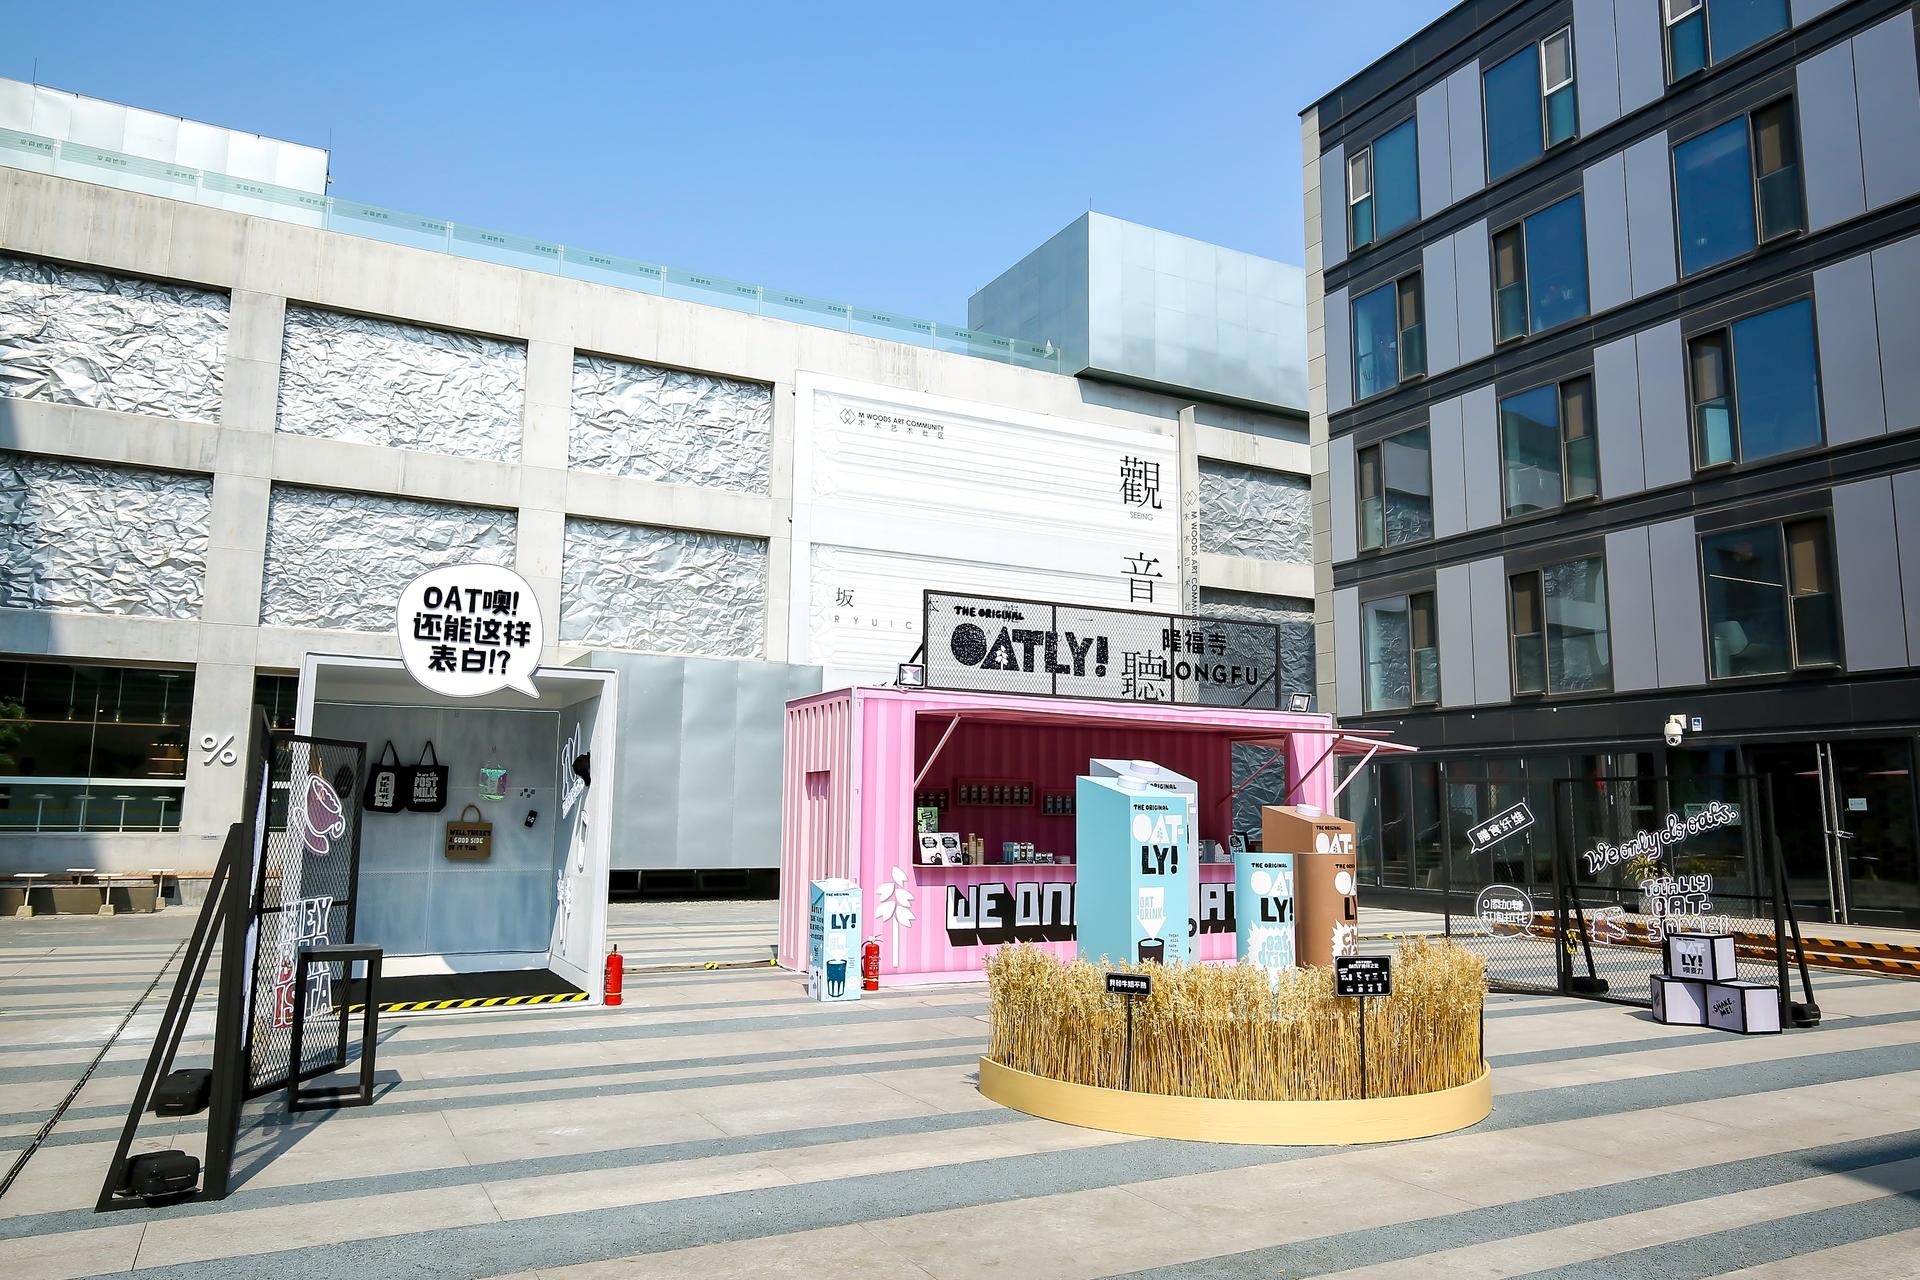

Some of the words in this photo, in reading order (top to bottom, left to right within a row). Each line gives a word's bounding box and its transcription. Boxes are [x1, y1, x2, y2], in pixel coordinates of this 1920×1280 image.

[867, 413, 892, 423] WOODS
[893, 417, 904, 425] ART
[906, 419, 945, 431] COMMUNITY
[1119, 455, 1163, 509] 觀
[1129, 510, 1154, 521] SEEING
[1120, 551, 1164, 603] 音
[423, 586, 520, 616] OAT噢!
[835, 587, 855, 608] 坂
[953, 605, 977, 617] THE
[978, 608, 1025, 620] ORIGINAL
[413, 611, 531, 647] 还能这样
[1162, 628, 1227, 656] 隆福寺
[428, 644, 511, 675] 表白!?
[950, 622, 1109, 678] OATLY!
[1161, 659, 1258, 686] LONGFU
[413, 787, 438, 797] MILK
[414, 776, 438, 788] POST
[1150, 782, 1177, 790] RIGINAL
[1133, 803, 1145, 811] THE
[1132, 813, 1185, 845] OAT-
[1476, 810, 1526, 844] 膳食纤维
[1583, 842, 1620, 873] We
[1619, 829, 1661, 861] only
[1659, 813, 1687, 845] do
[1686, 801, 1739, 835] oats.
[1141, 845, 1179, 875] LY!
[946, 882, 1007, 937] WE
[1015, 882, 1077, 930] ON
[1139, 896, 1154, 908] OAT
[1139, 907, 1163, 920] DRINK
[1260, 896, 1294, 923] LY!
[1651, 893, 1714, 918] OAT-
[280, 897, 334, 942] HEY
[831, 913, 857, 930] LY!
[1681, 953, 1704, 967] LY!
[1712, 997, 1733, 1013] SHAKE
[1719, 1006, 1733, 1017] ME!
